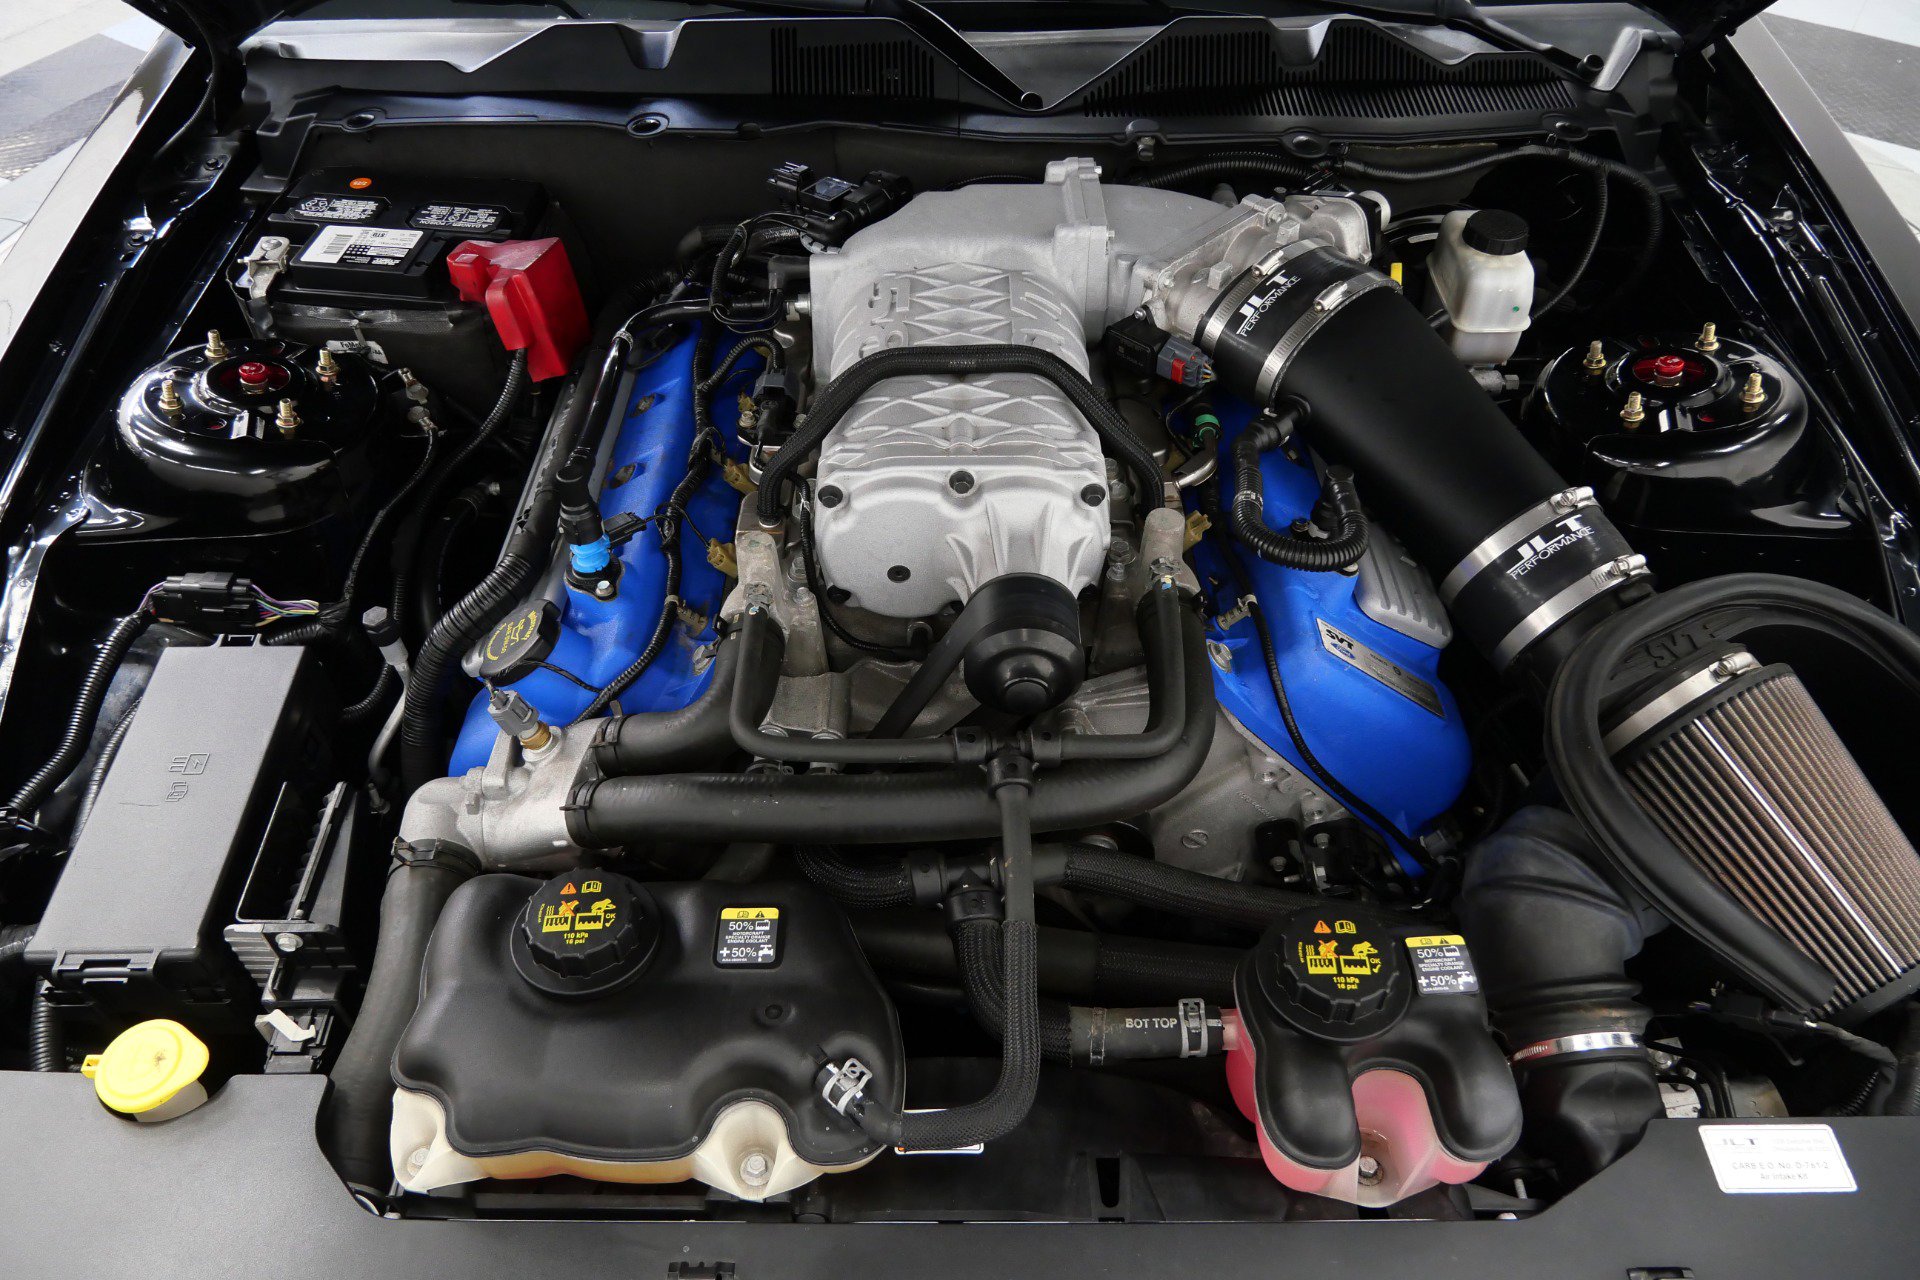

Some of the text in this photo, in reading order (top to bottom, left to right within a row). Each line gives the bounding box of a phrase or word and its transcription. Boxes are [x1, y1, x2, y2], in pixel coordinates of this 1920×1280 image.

[1236, 269, 1286, 335] JLT
[1240, 275, 1302, 337] PERFORMANCE
[1506, 514, 1583, 574] JLT
[1510, 525, 1595, 580] PERFORMANCE
[1326, 628, 1354, 650] SVT
[728, 921, 754, 931] 50%
[576, 931, 589, 939] kPa
[574, 938, 586, 946] psi
[1416, 947, 1444, 959] 50%
[1346, 976, 1360, 984] kPa
[1346, 983, 1358, 991] psi
[1125, 1017, 1150, 1029] BOT
[1152, 1017, 1177, 1029] TOP
